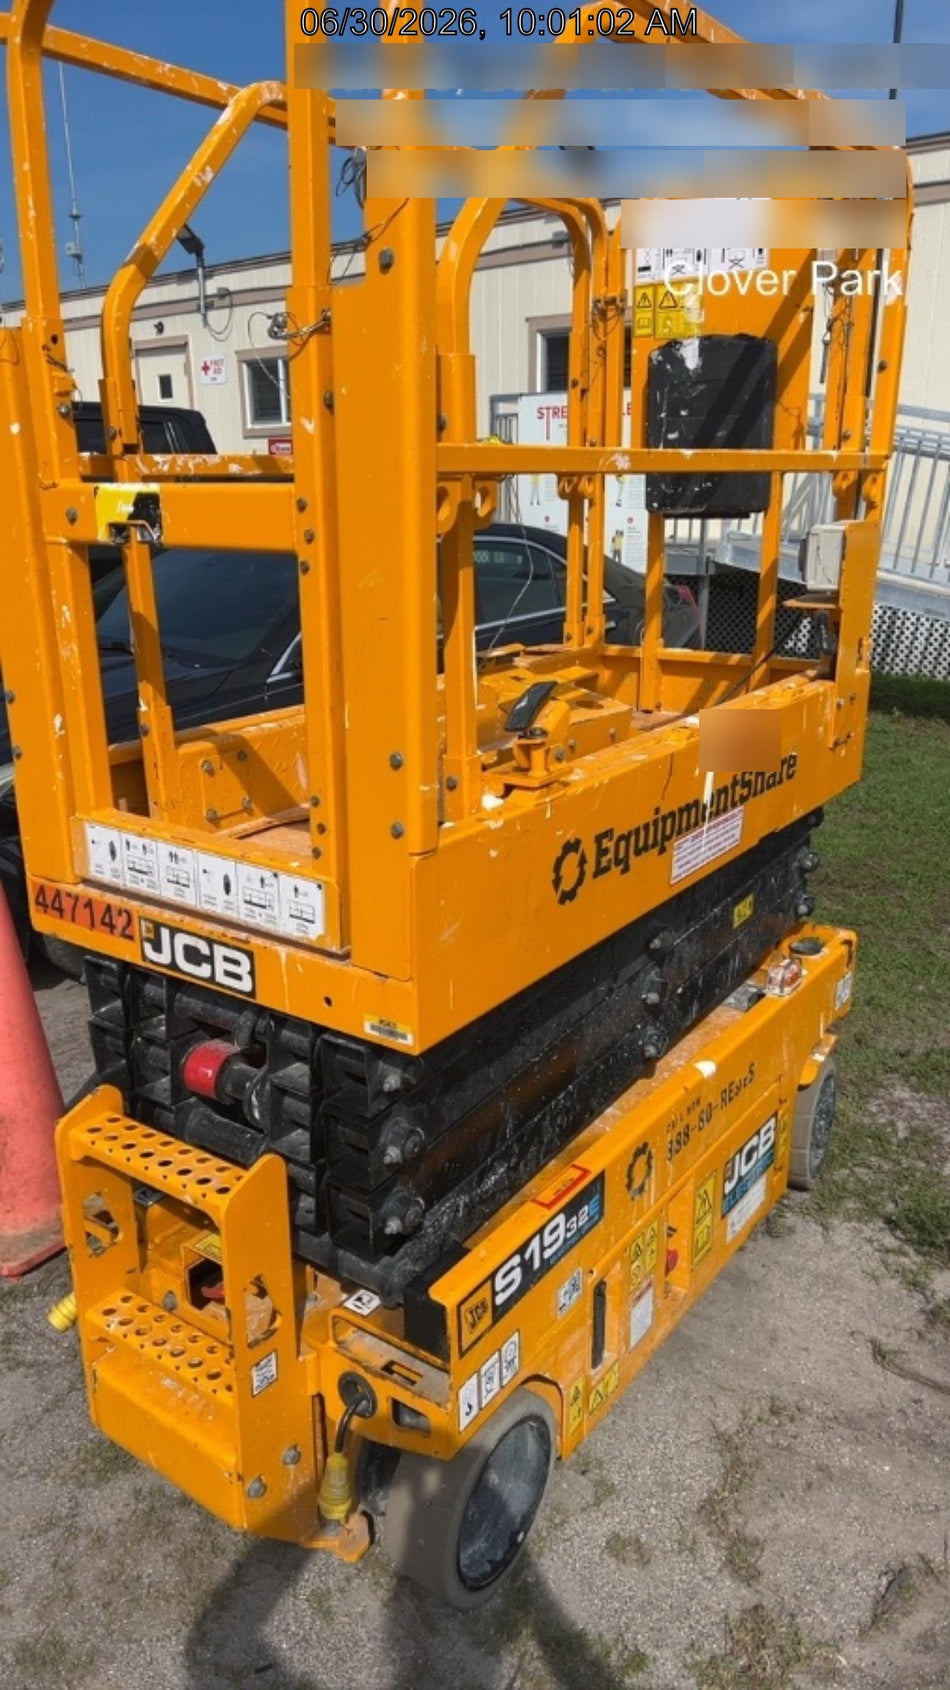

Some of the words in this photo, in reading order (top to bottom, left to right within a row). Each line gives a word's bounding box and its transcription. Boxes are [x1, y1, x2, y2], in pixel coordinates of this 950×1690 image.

[592, 753, 798, 880] EquipmentShare
[34, 884, 135, 941] 447142
[142, 926, 253, 993] JCB
[724, 1115, 776, 1196] JCB
[494, 1193, 601, 1306] S1932E
[465, 1297, 489, 1333] JCB
